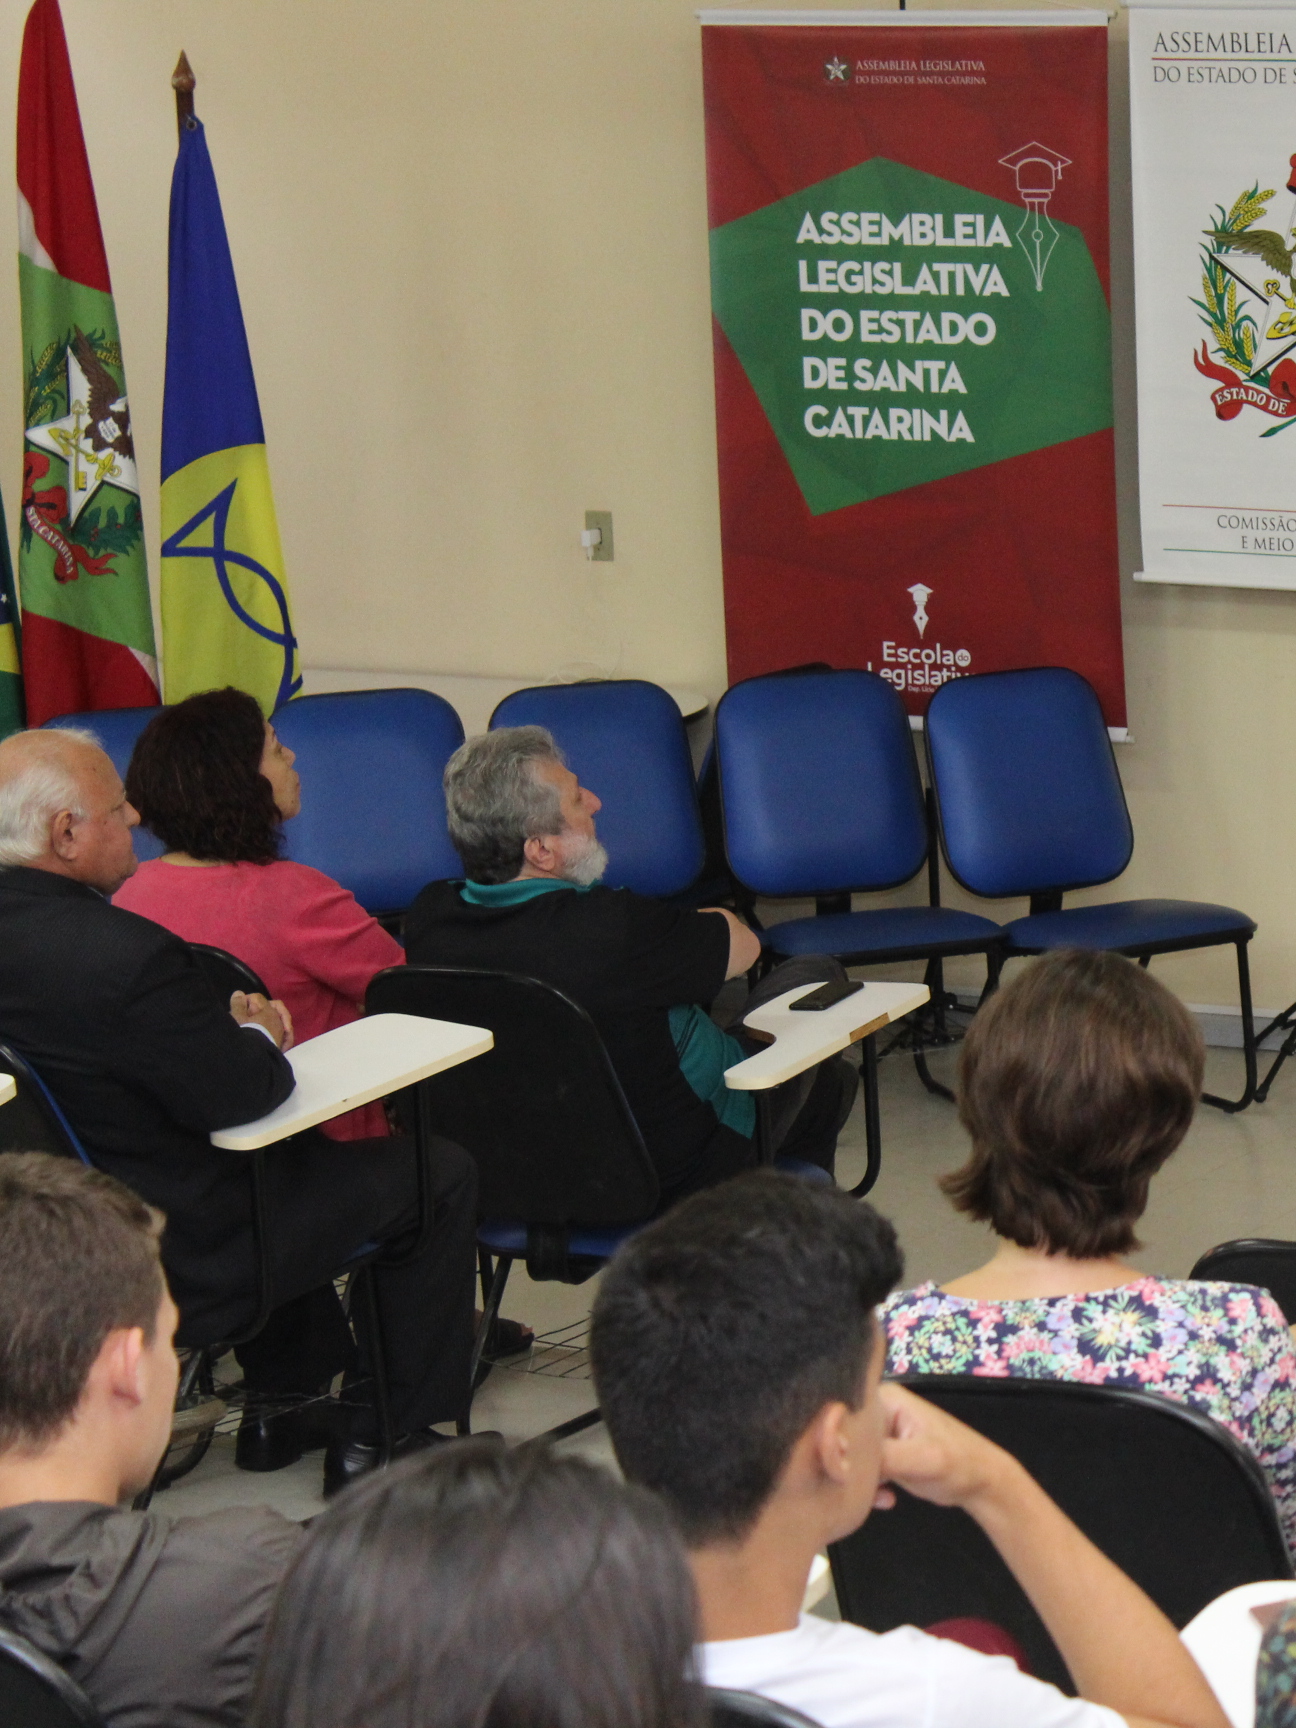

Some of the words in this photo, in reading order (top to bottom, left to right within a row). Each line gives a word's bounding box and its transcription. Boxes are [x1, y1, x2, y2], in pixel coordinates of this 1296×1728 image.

[1153, 30, 1294, 54] ASSEMBLEIA
[856, 60, 918, 71] ASSEMBLEIA
[920, 60, 985, 72] LEGISLATIVA
[1153, 65, 1181, 84] DO
[1187, 66, 1257, 85] ESTADO
[1263, 66, 1287, 85] DE
[855, 76, 870, 84] DO
[871, 76, 902, 85] ESTADO
[904, 76, 915, 84] DE
[917, 76, 944, 85] SANTA
[945, 77, 987, 86] CATARINA
[796, 211, 1012, 248] ASSEMBLEIA
[799, 260, 1010, 297] LEGISLATIVA
[801, 308, 854, 342] DO
[859, 310, 997, 346] ESTADO
[803, 357, 848, 390] DE
[852, 359, 968, 394] SANTA
[1215, 390, 1267, 406] ESTADO
[1268, 398, 1288, 415] DE
[804, 405, 975, 443] CATARINA
[1241, 536, 1248, 549] E
[1254, 537, 1295, 552] MEIO
[882, 641, 954, 665] Escola
